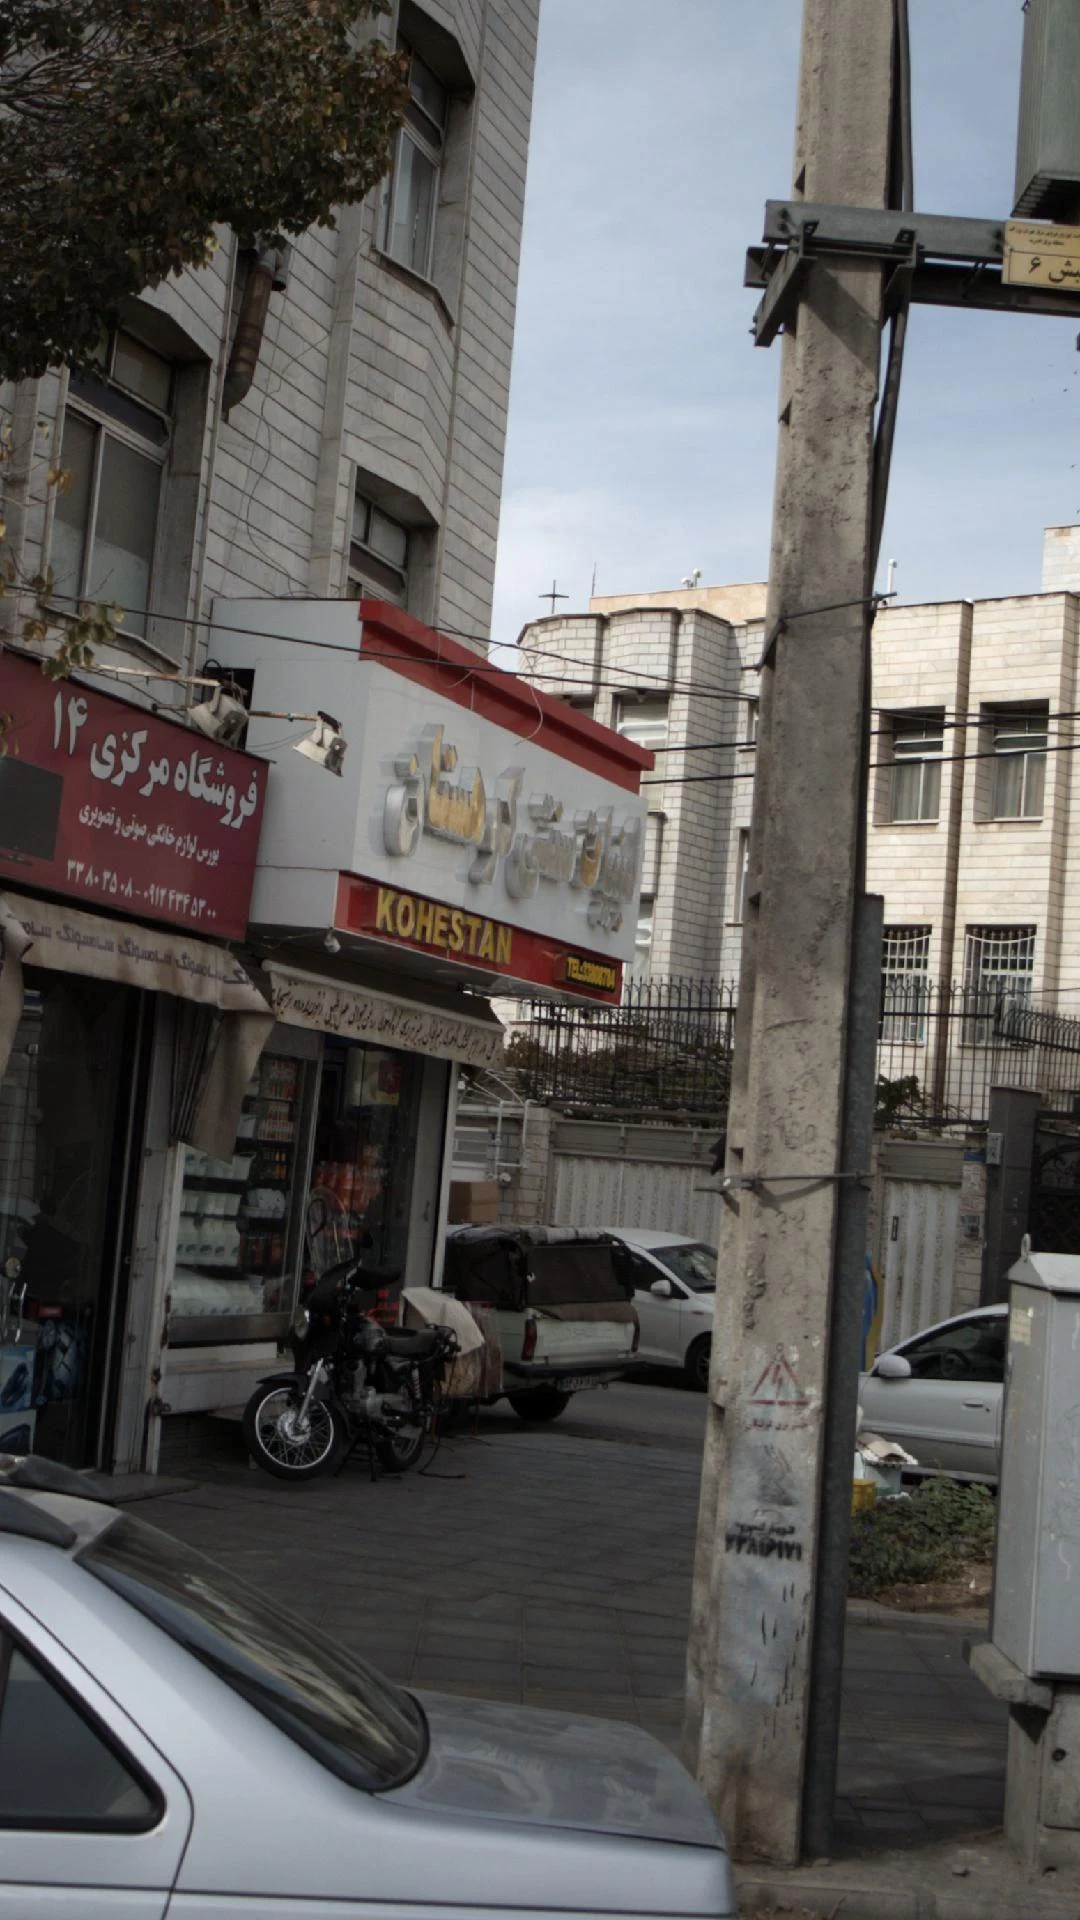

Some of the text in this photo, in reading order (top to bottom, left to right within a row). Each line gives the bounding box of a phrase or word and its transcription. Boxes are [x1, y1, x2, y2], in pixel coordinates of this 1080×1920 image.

[1028, 256, 1041, 274] ۶
[54, 691, 258, 829] فروشگاه مرکزی ۱۴
[79, 803, 115, 829] تصویری
[147, 823, 175, 847] خانگی
[175, 833, 198, 858] لوازم
[375, 888, 512, 965] KOHESTAN
